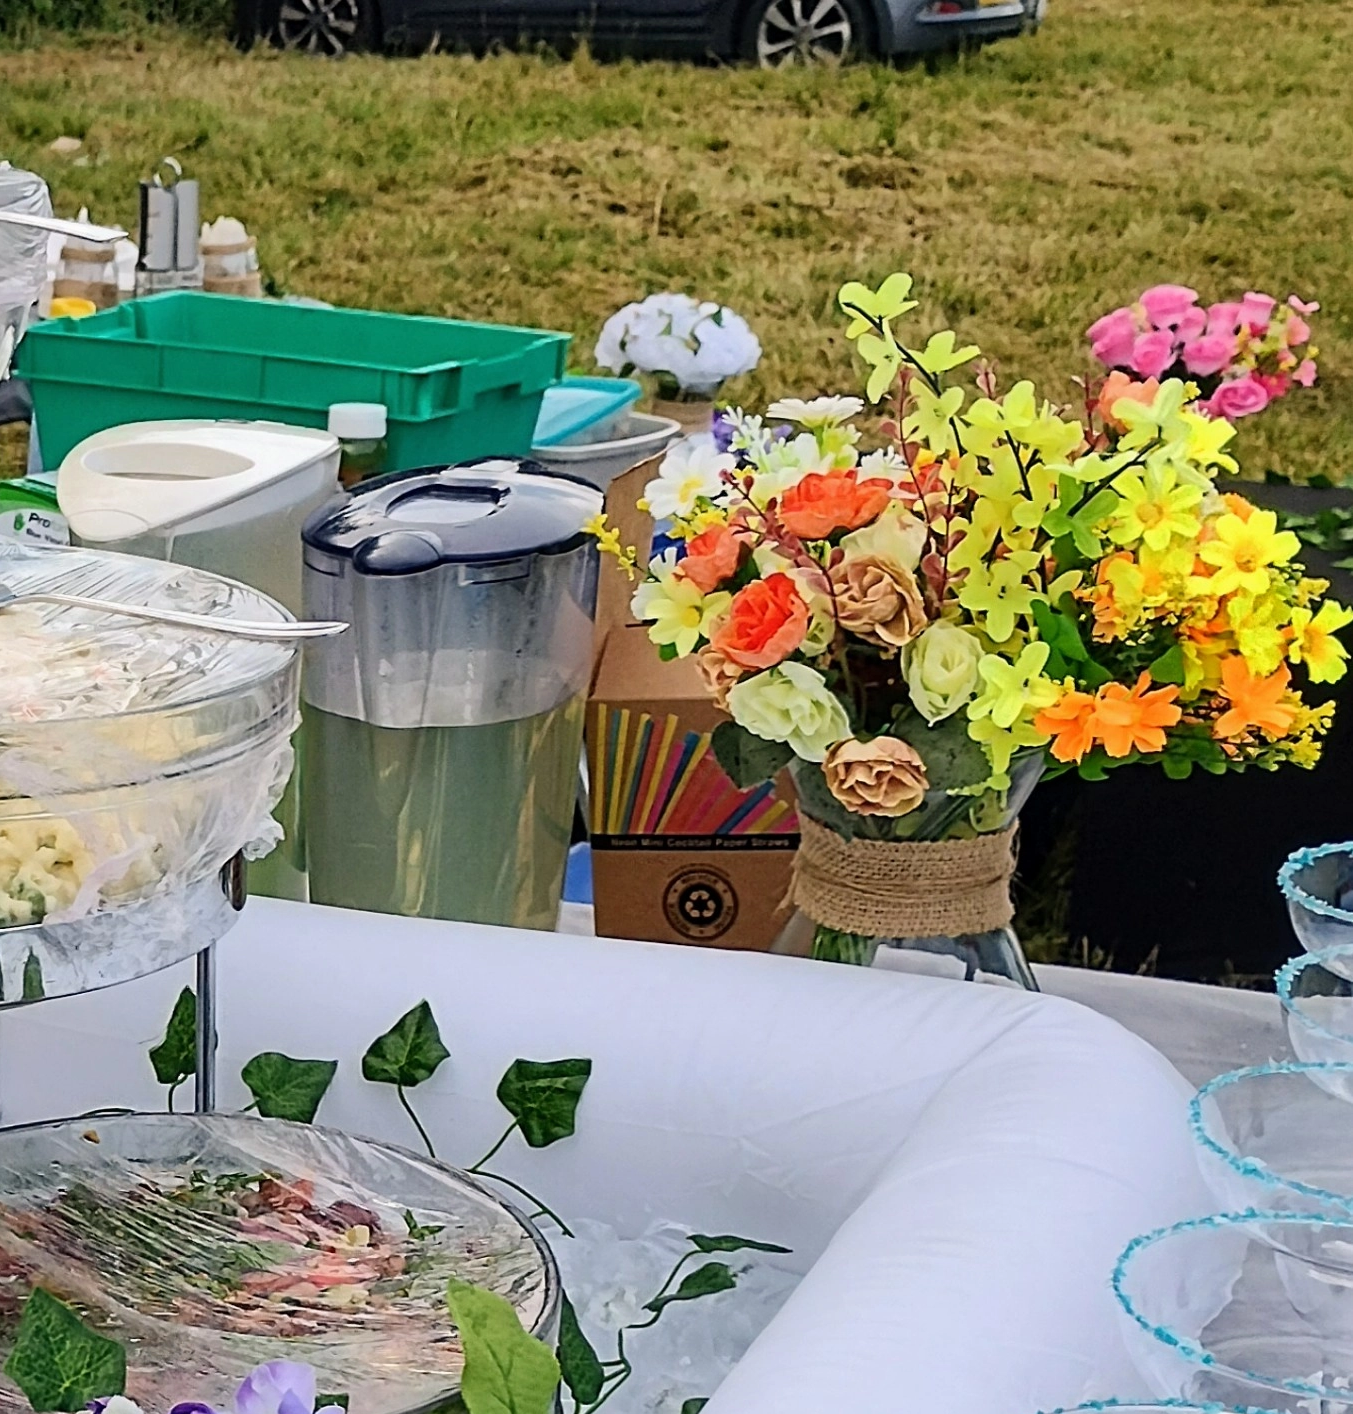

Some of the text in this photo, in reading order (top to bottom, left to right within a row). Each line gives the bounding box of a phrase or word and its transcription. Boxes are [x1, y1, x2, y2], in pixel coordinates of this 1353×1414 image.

[666, 838, 712, 848] Cocktail
[715, 837, 747, 849] Paper
[750, 837, 790, 847] Straws
